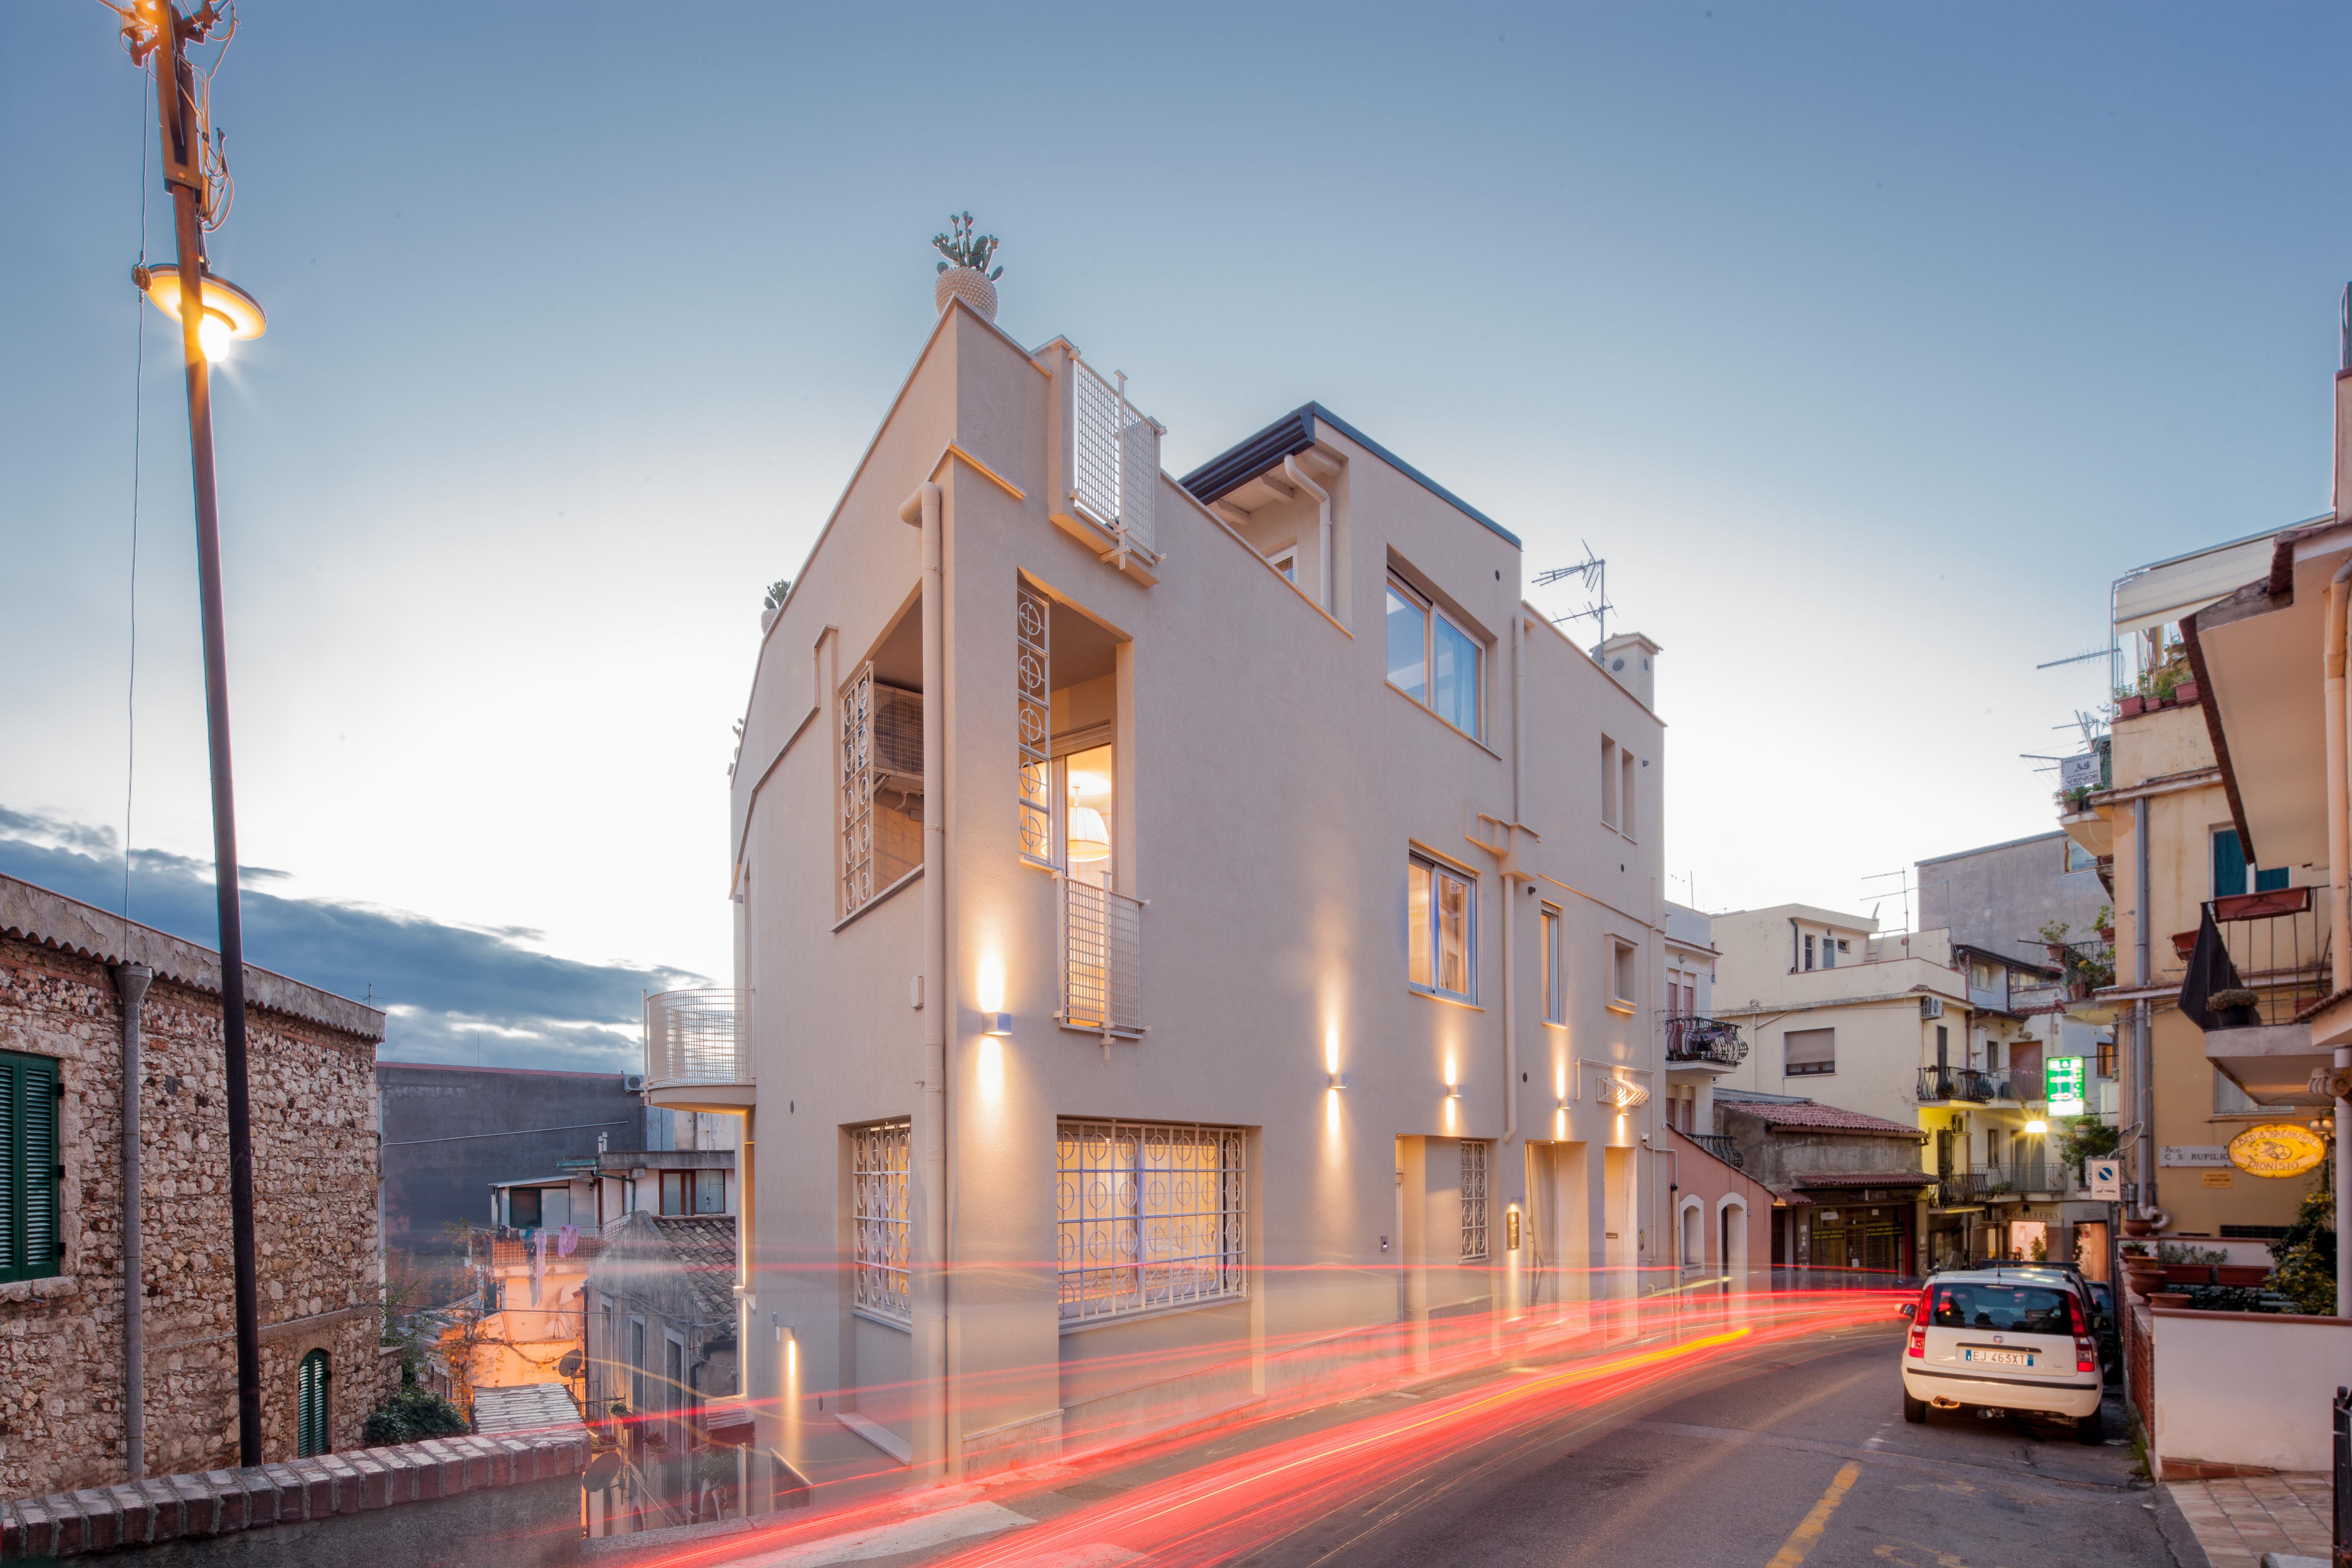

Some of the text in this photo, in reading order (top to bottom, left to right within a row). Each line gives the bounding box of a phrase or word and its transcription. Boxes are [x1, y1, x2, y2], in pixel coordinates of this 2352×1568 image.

[2066, 774, 2099, 784] VENDE
[2238, 1135, 2256, 1145] BED
[2269, 1131, 2316, 1144] BREAKFAST
[2248, 1161, 2299, 1170] DIONISIO
[1973, 1351, 2025, 1364] EJ 463XT
